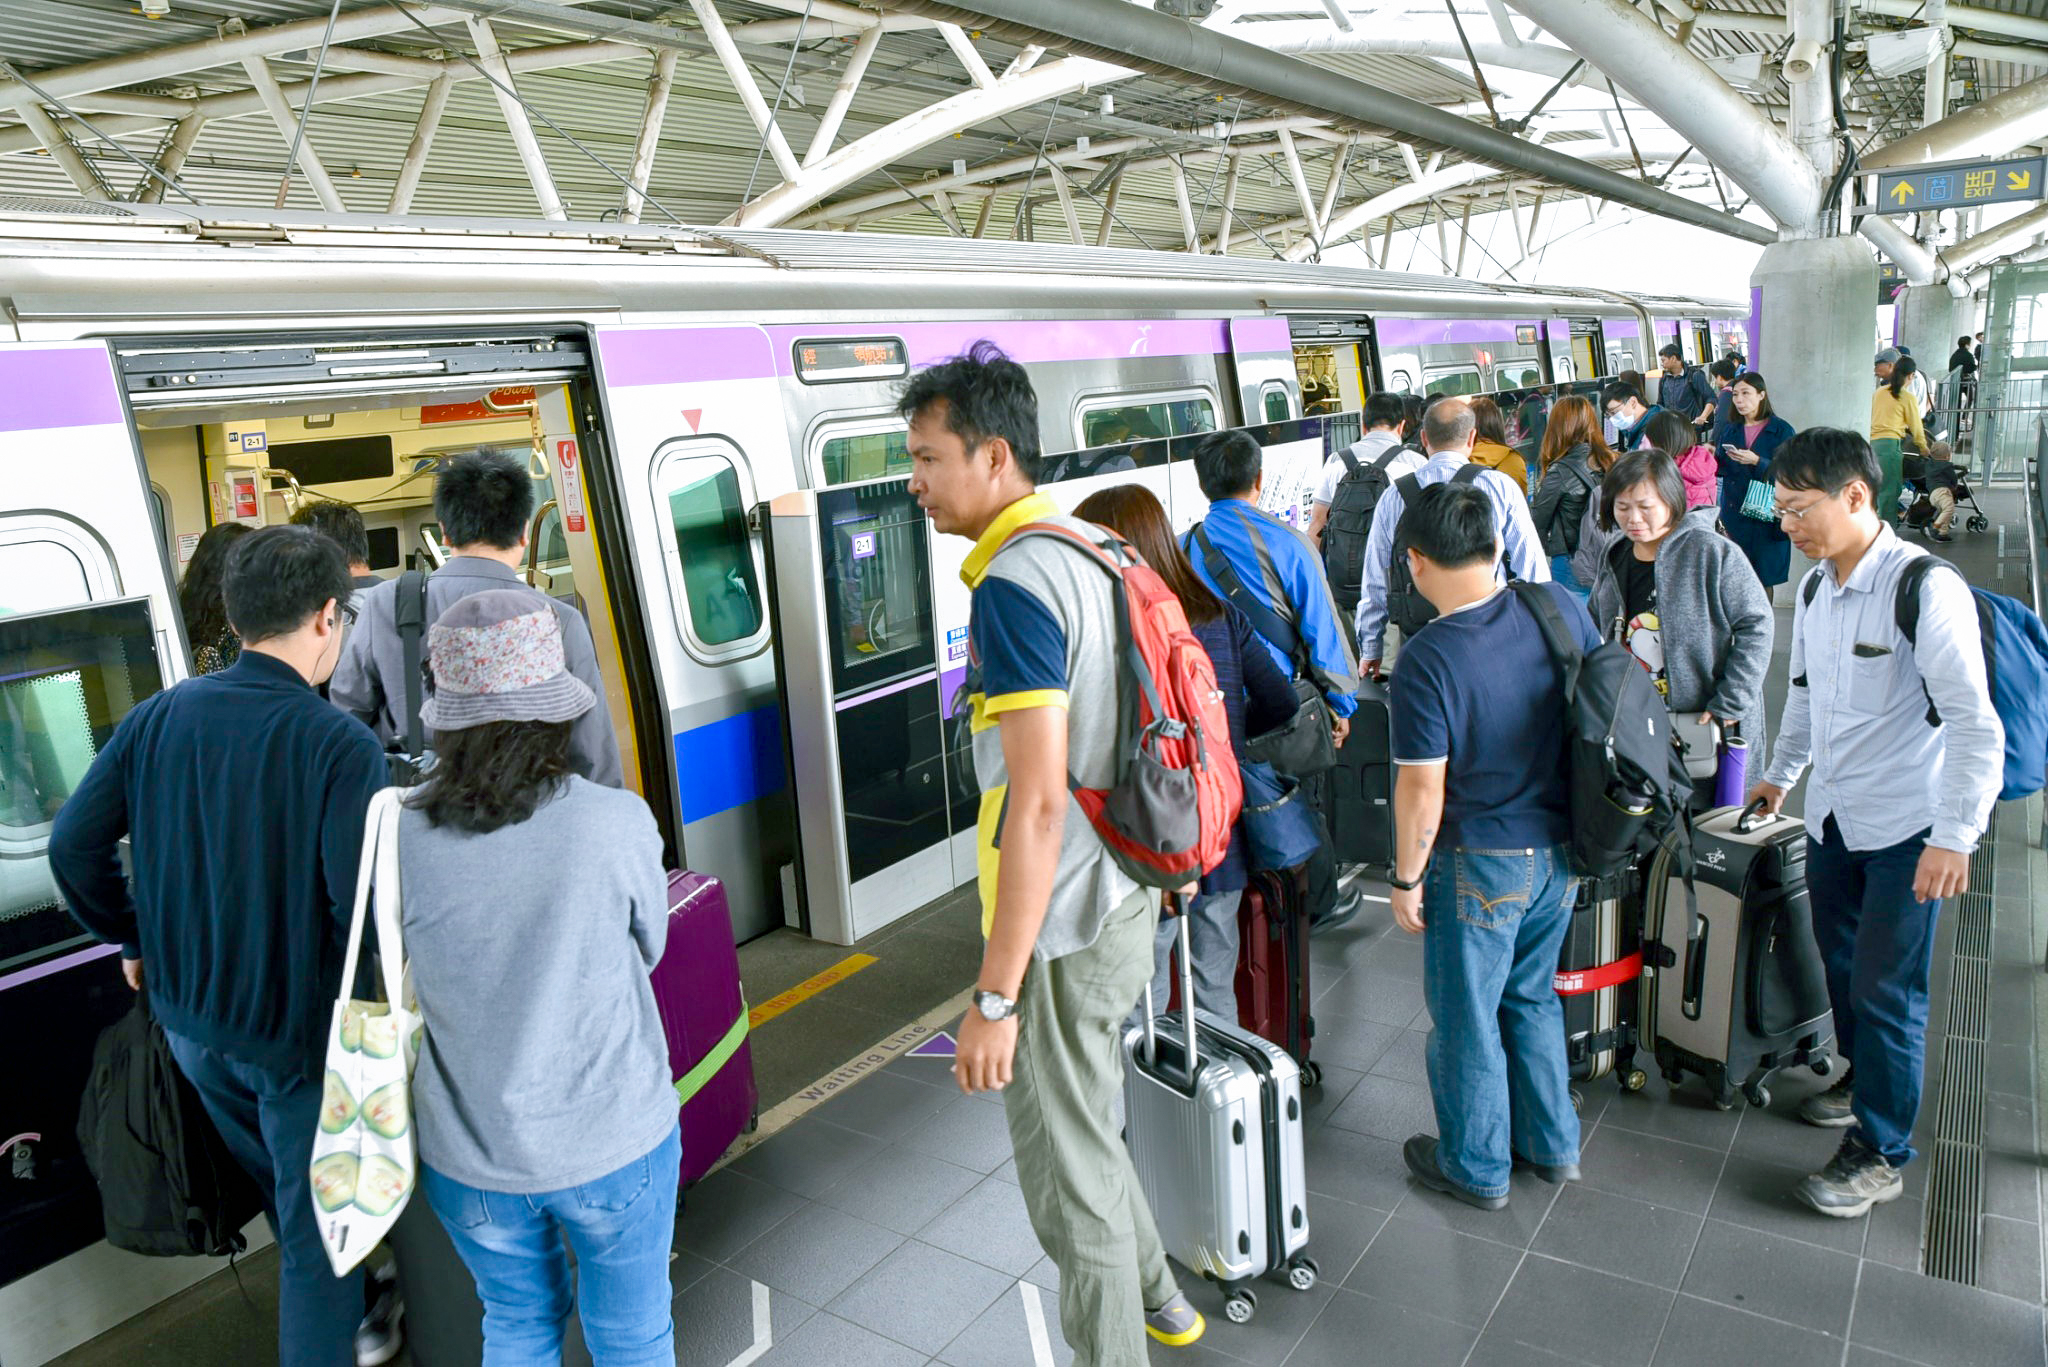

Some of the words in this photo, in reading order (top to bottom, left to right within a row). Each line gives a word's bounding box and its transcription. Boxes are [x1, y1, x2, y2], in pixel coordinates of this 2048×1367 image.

[1965, 170, 1996, 187] 出口
[1964, 186, 1994, 198] EXIT
[247, 438, 260, 446] 2-1
[856, 539, 870, 552] 2-1
[799, 1053, 885, 1101] Waiting
[880, 1025, 927, 1052] Line
